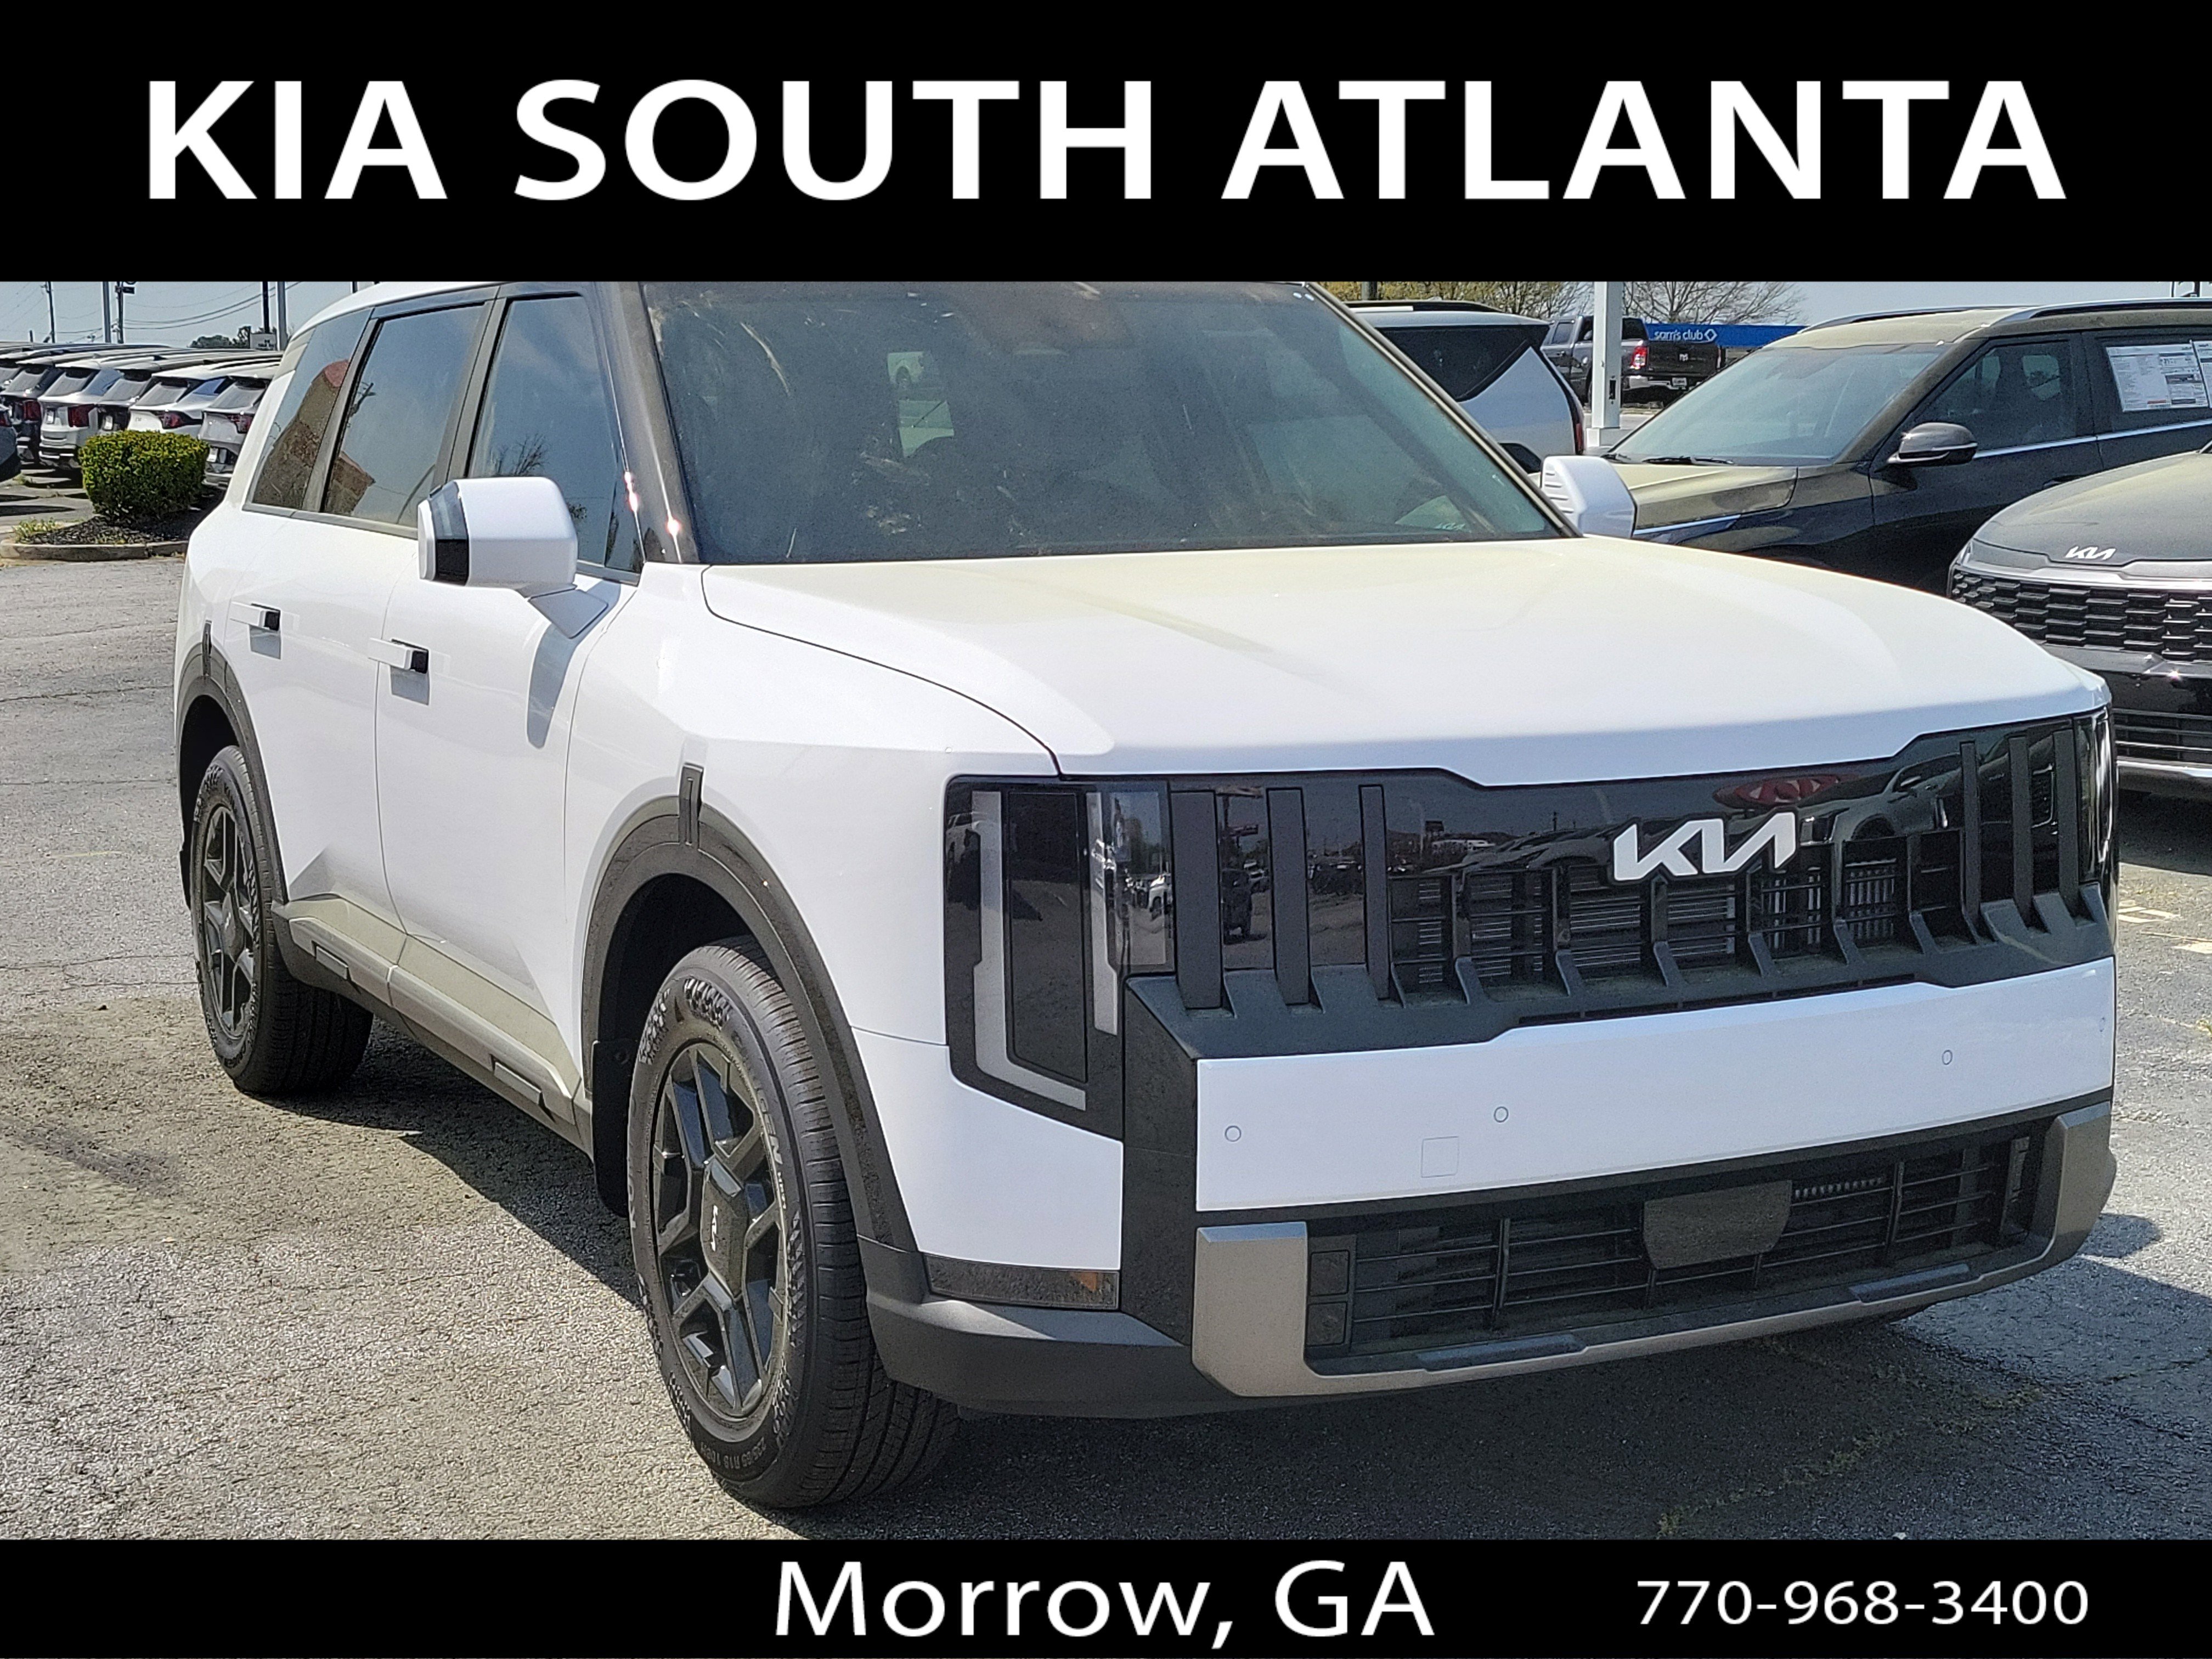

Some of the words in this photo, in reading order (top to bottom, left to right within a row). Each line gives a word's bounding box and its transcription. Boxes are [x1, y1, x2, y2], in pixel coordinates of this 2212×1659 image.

[1654, 329, 1681, 341] sam's
[1682, 329, 1703, 340] club
[2065, 546, 2116, 560] KIA
[1614, 812, 1796, 881] KIA
